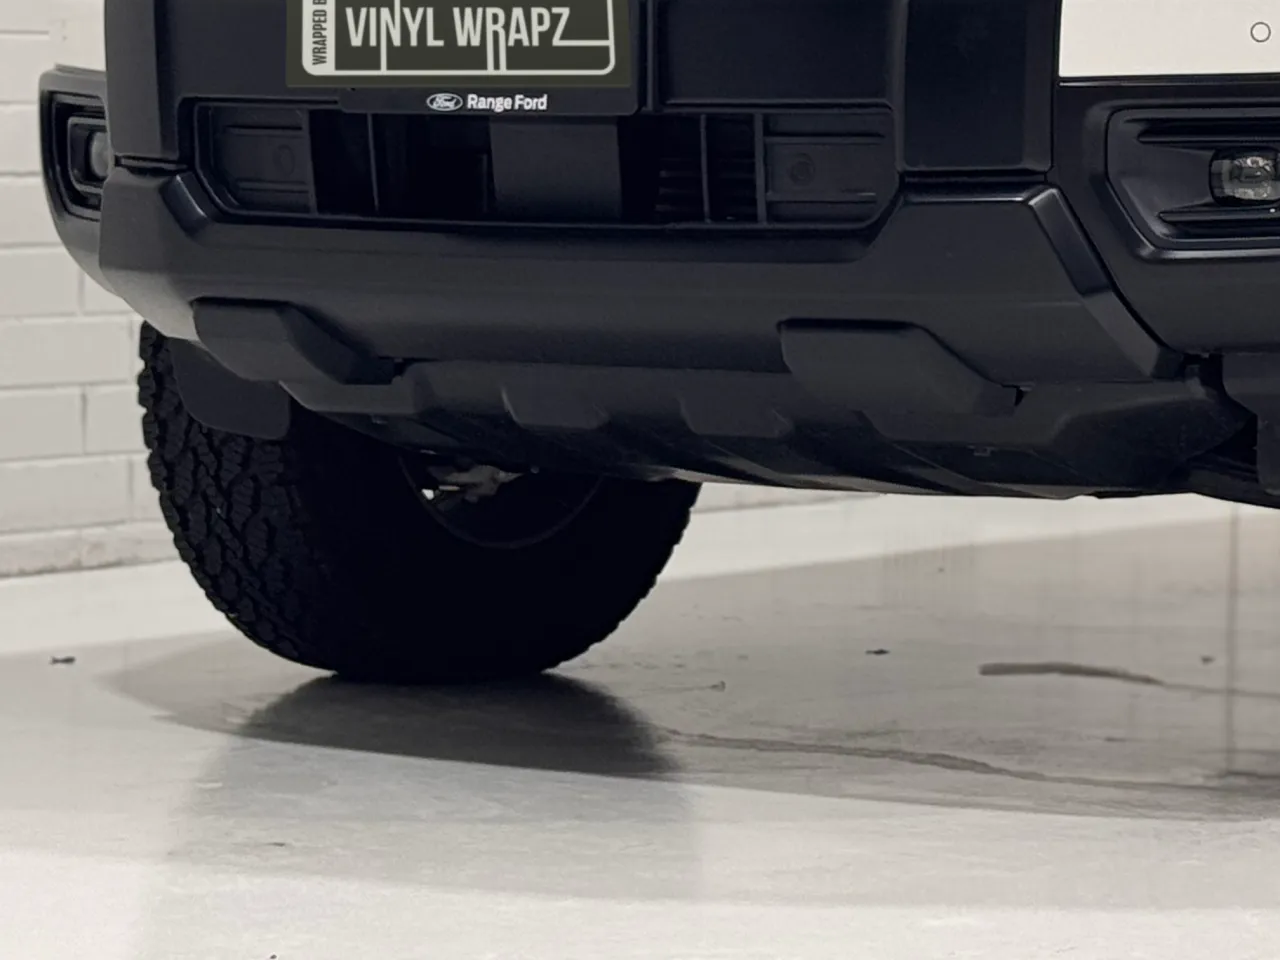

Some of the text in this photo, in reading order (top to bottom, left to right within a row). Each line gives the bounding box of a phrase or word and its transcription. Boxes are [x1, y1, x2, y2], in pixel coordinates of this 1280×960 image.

[312, 9, 327, 66] WRAPPED
[453, 6, 572, 69] WRAPZ
[466, 94, 512, 112] Range
[513, 94, 548, 110] Ford
